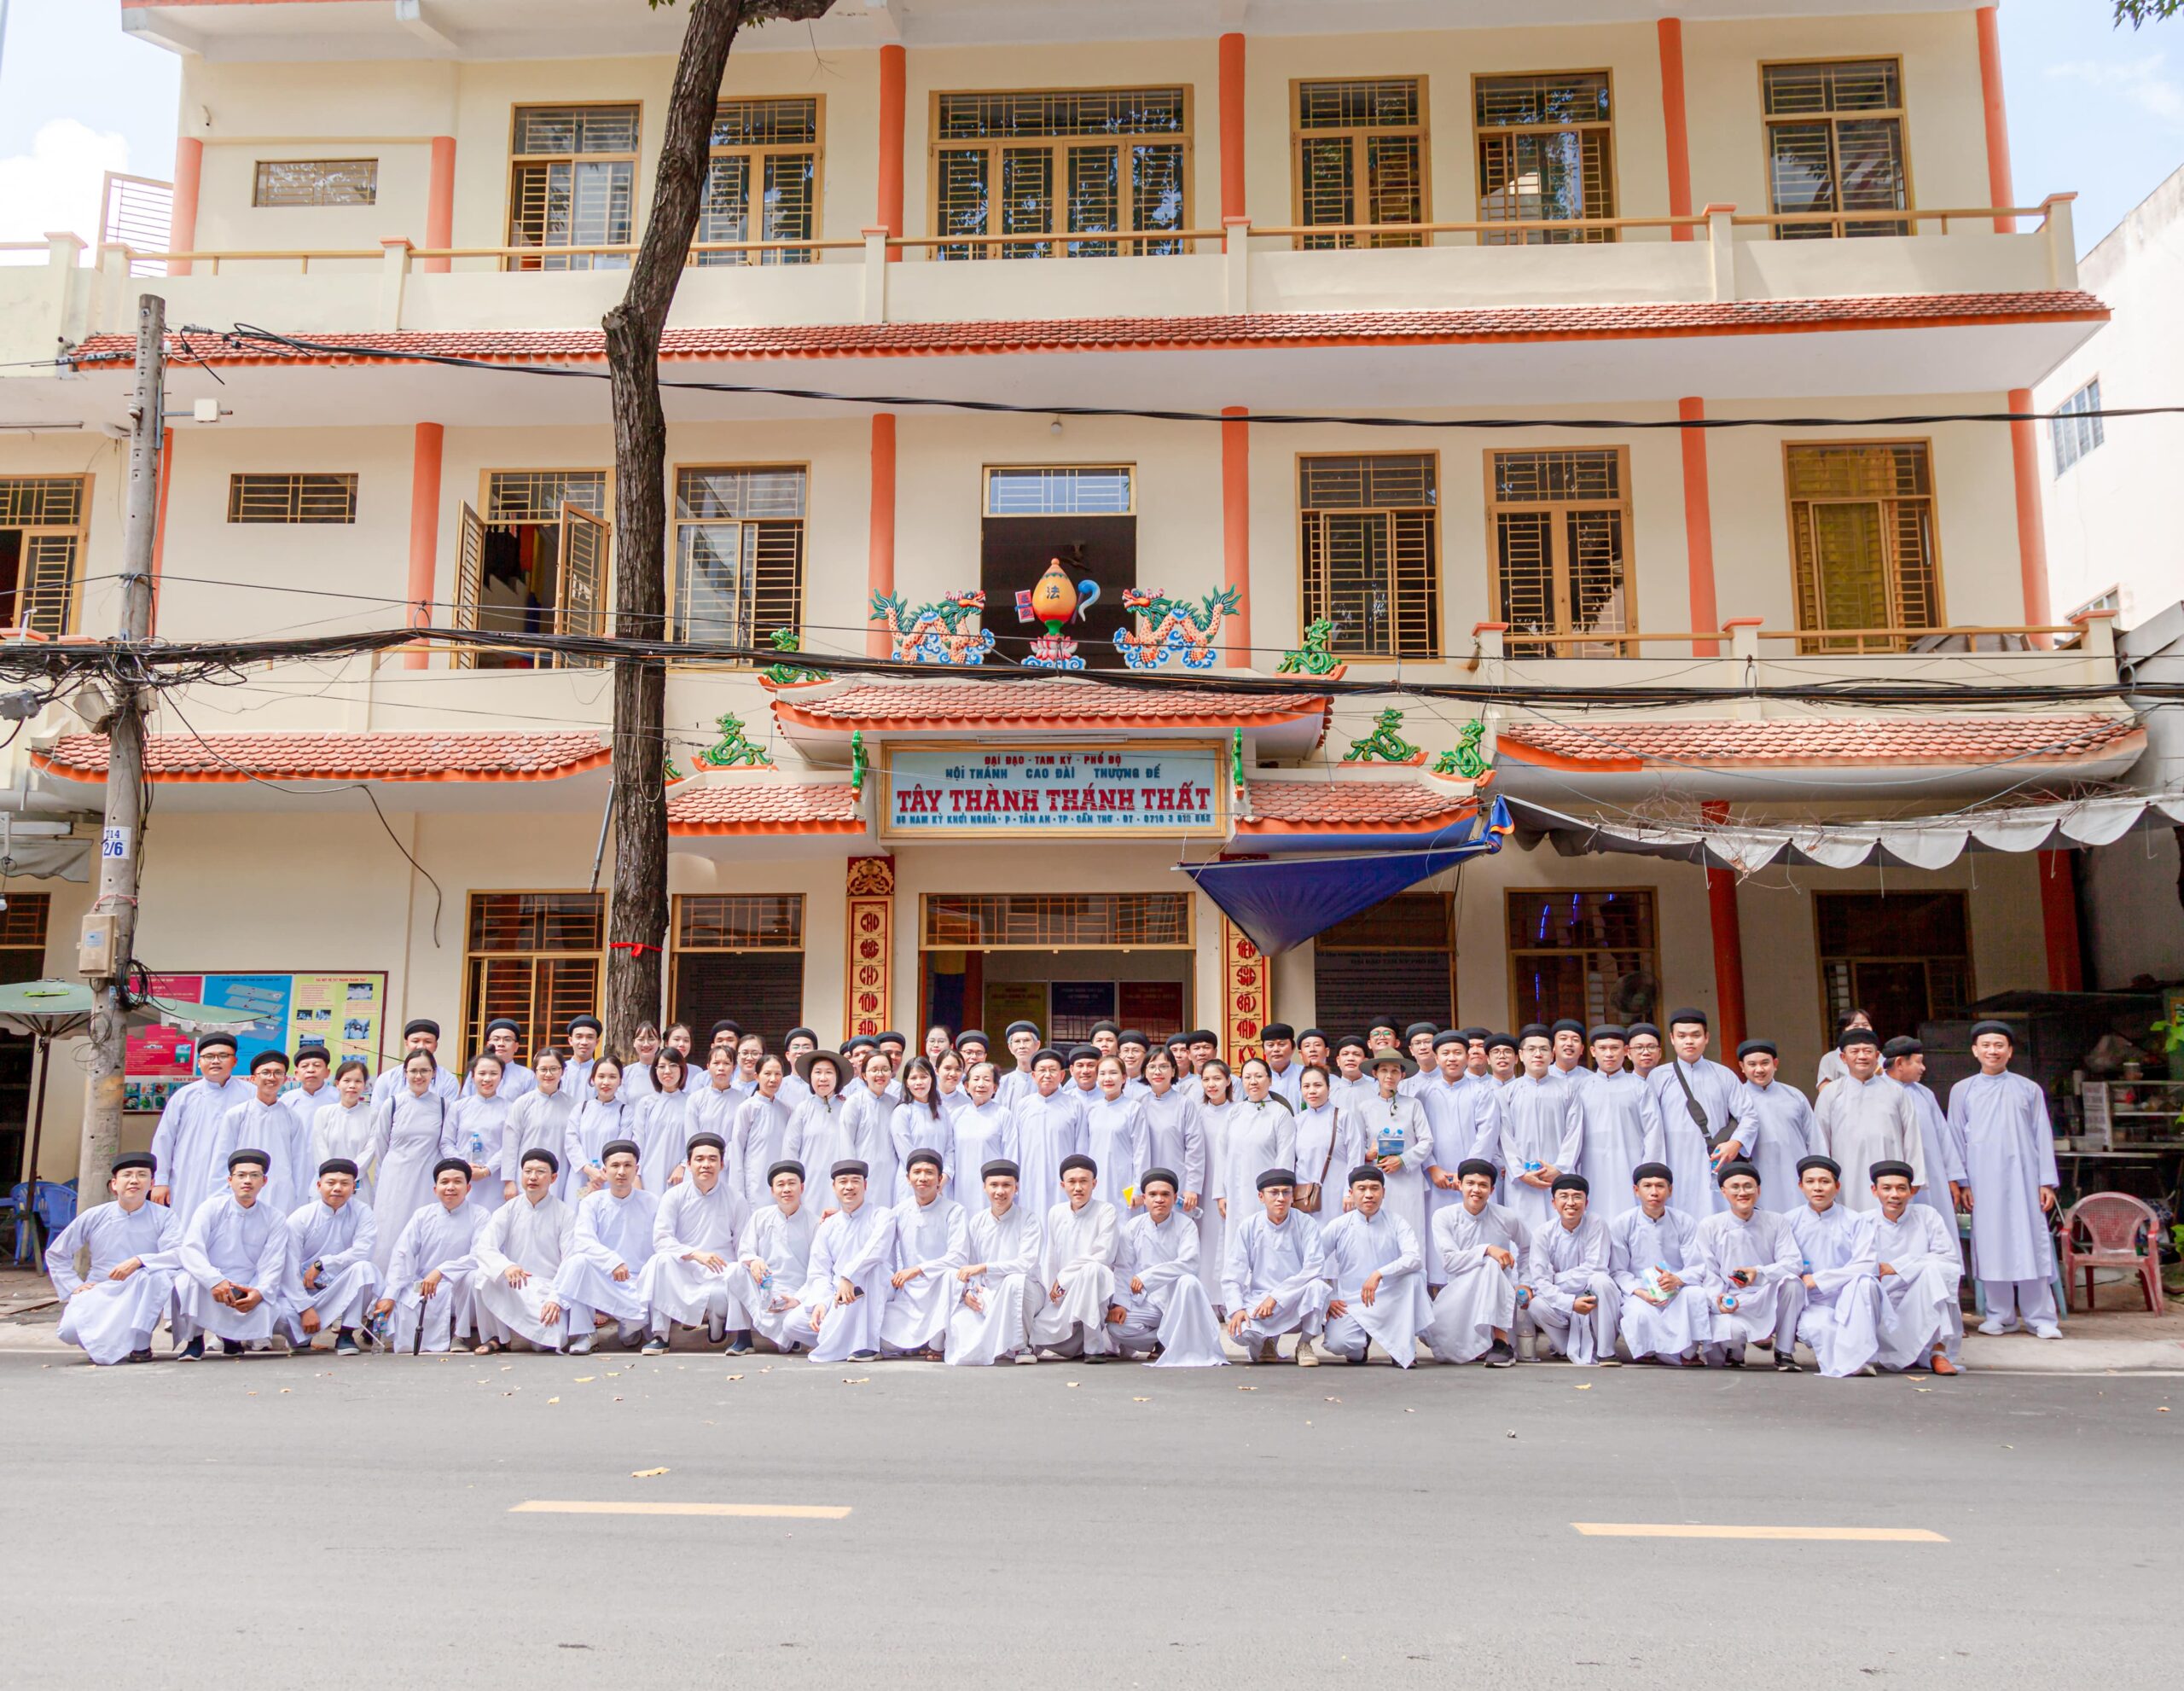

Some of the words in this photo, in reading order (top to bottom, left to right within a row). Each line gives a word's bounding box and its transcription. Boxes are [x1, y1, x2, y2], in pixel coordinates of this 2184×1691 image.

[985, 753, 1001, 767] ĐẠI
[1005, 756, 1025, 767] ĐẠO
[1035, 756, 1054, 765] TAM
[1083, 751, 1104, 764] PHỔ
[1108, 753, 1122, 767] ĐỘ
[945, 765, 965, 781] HỘI
[969, 766, 1008, 780] THÁNH
[1025, 768, 1049, 779] CAO
[1055, 766, 1075, 779] ĐÀI
[1094, 768, 1140, 781] THƯỢNG
[1146, 764, 1161, 779] ĐẾ
[897, 783, 943, 812] TÂY
[950, 783, 1039, 812] THÀNH
[1046, 782, 1136, 811] THÁNH
[1141, 780, 1211, 811] THẤT
[910, 816, 928, 824] NAM
[1019, 812, 1036, 824] TÂN
[1039, 815, 1050, 824] AN
[1058, 815, 1068, 824] TP
[1076, 811, 1093, 823] CẦN
[1096, 814, 1113, 823] THƠ
[1144, 814, 1164, 823] 0710
[103, 841, 124, 857] 2/6
